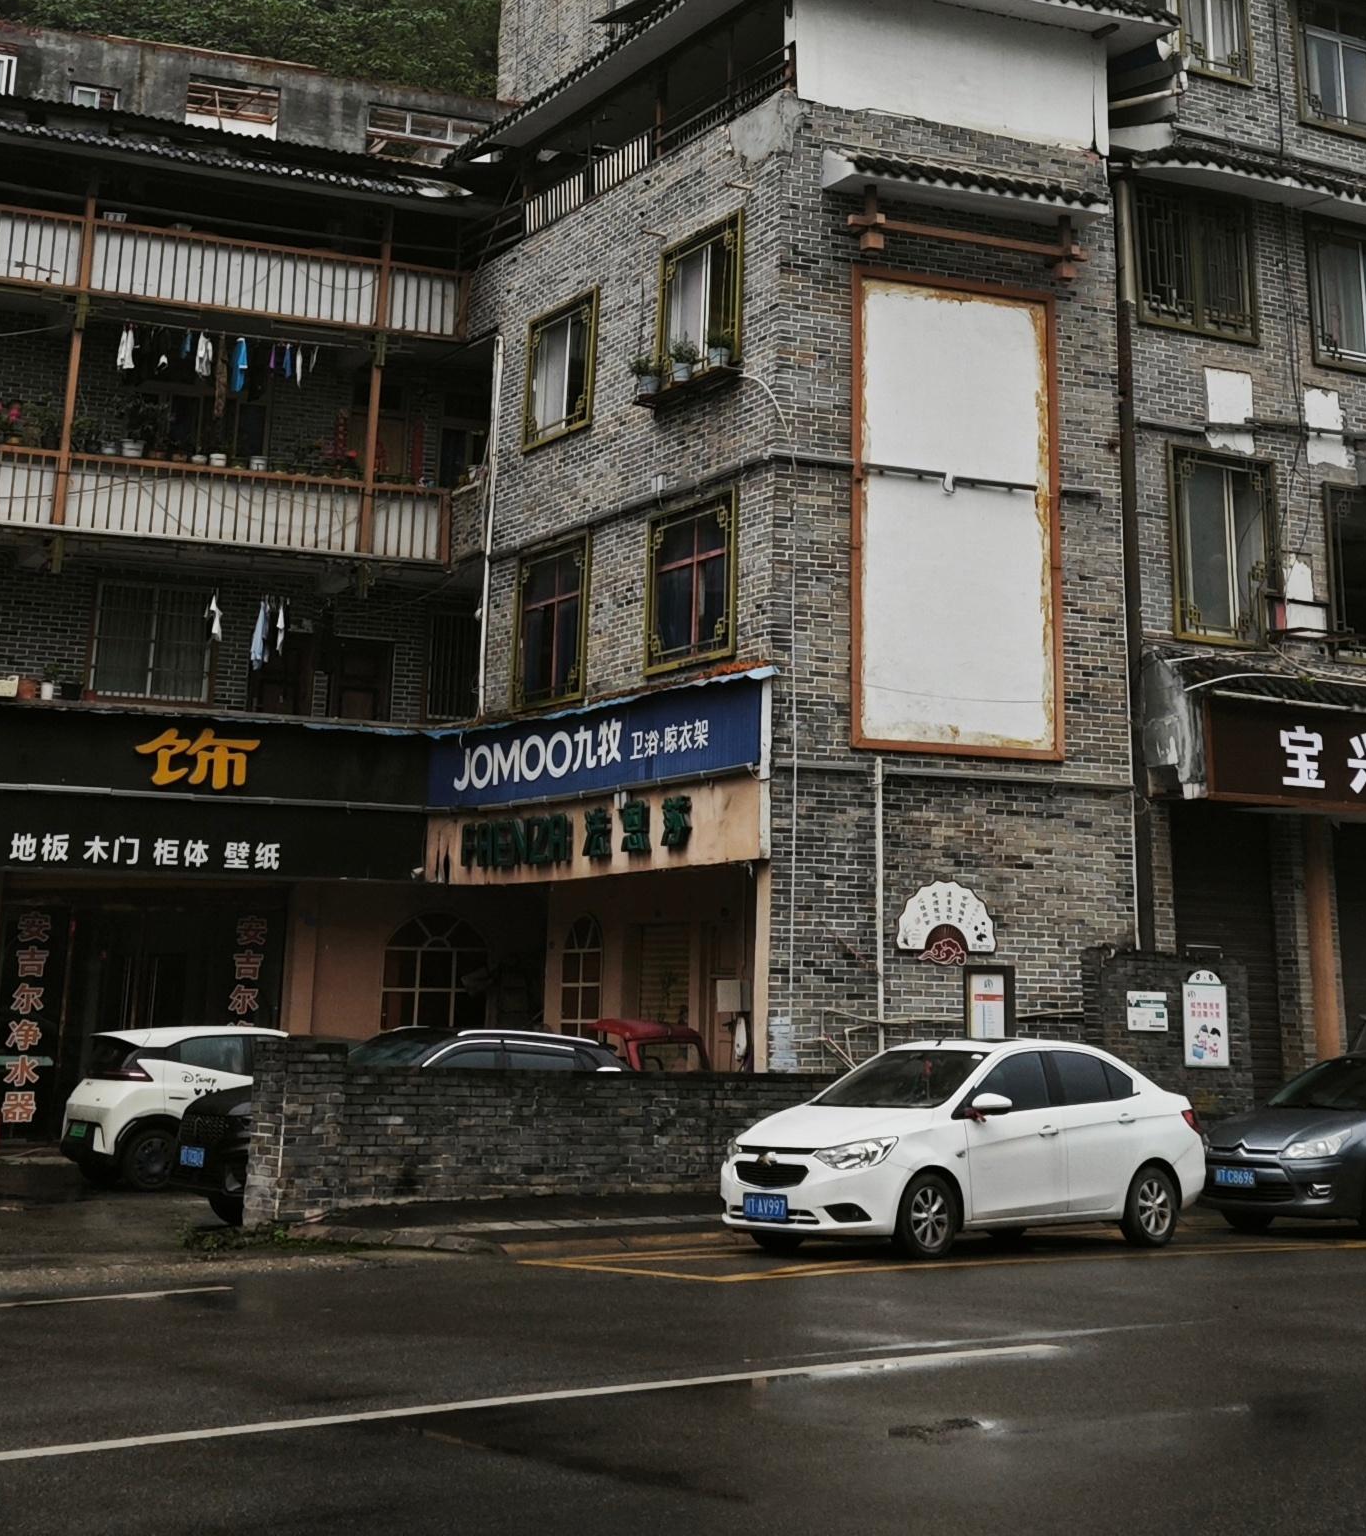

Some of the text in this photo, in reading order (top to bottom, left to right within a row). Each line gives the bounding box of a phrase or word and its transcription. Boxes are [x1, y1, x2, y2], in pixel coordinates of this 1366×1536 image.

[9, 832, 282, 871] 地板 木门 柜体 壁纸
[0, 911, 52, 1124] 安吉尔净水器
[226, 914, 268, 1026] 安吉尔
